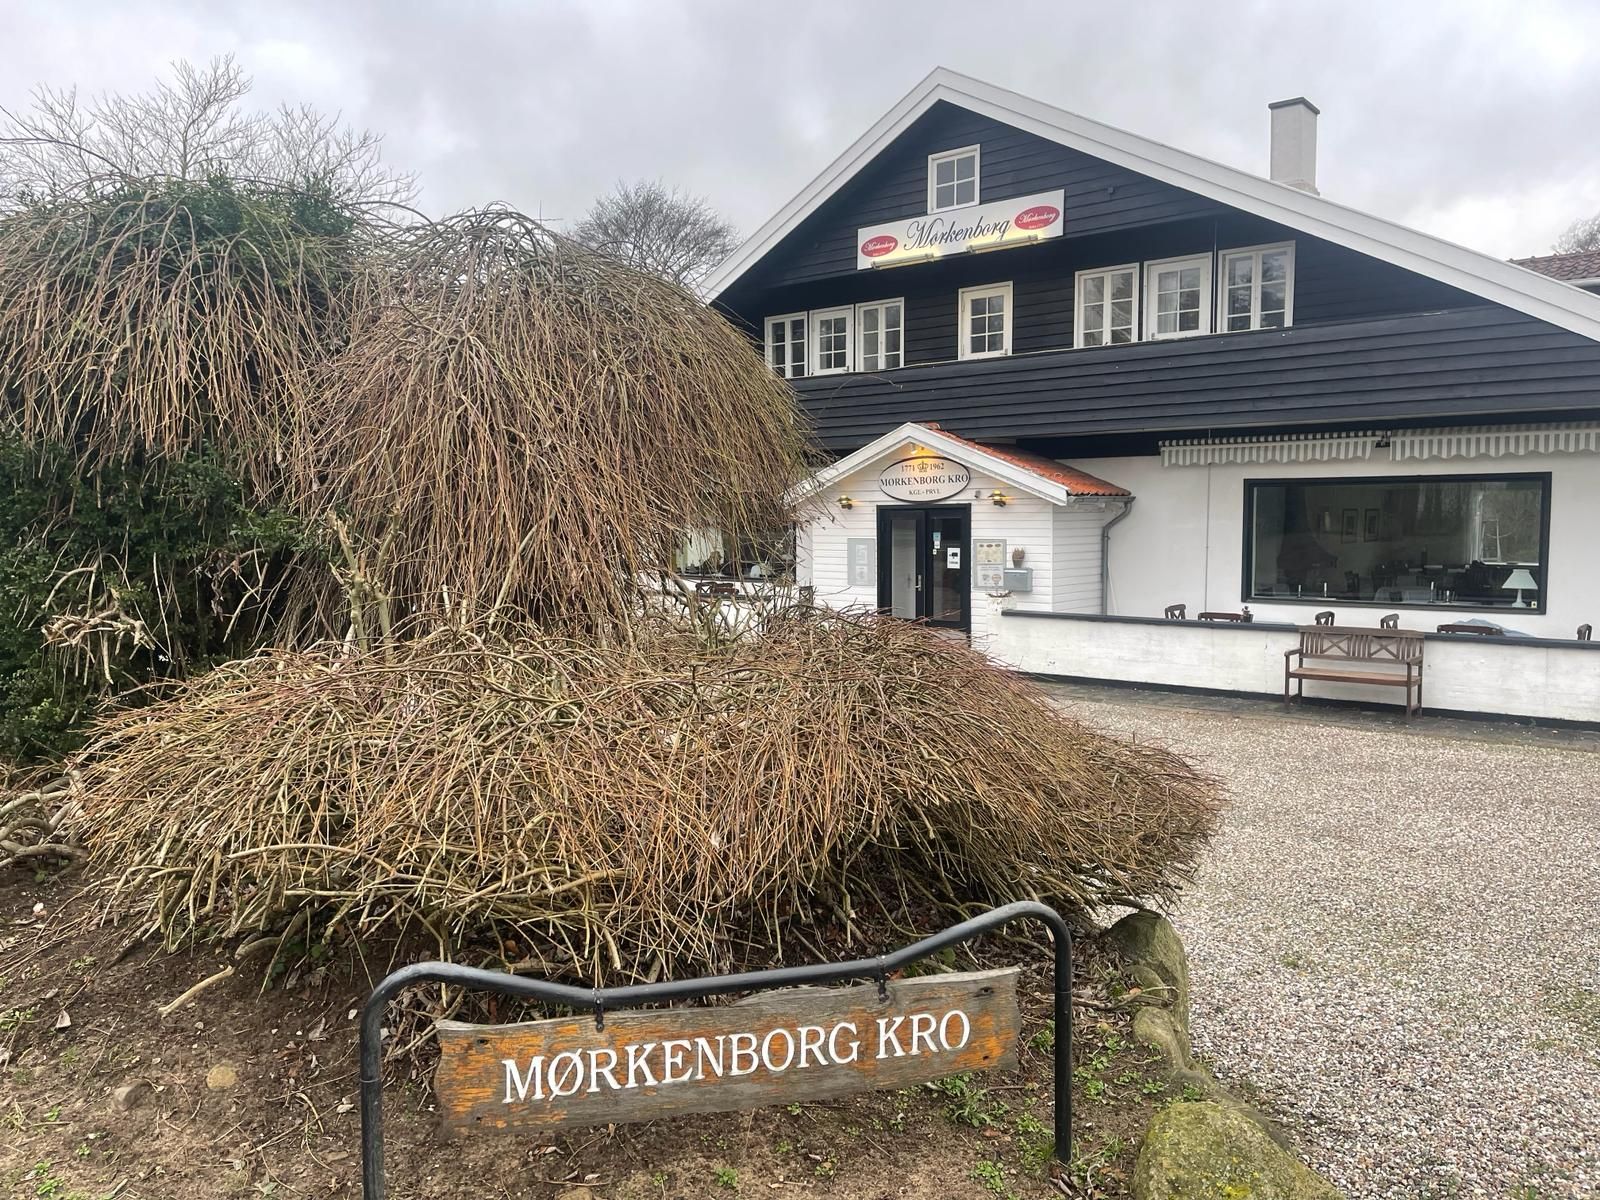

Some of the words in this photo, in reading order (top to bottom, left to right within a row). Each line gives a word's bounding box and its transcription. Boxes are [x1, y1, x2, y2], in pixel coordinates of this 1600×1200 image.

[948, 474, 968, 484] KRO
[501, 1022, 861, 1104] MØRKENBORG
[875, 1010, 972, 1059] KRO
